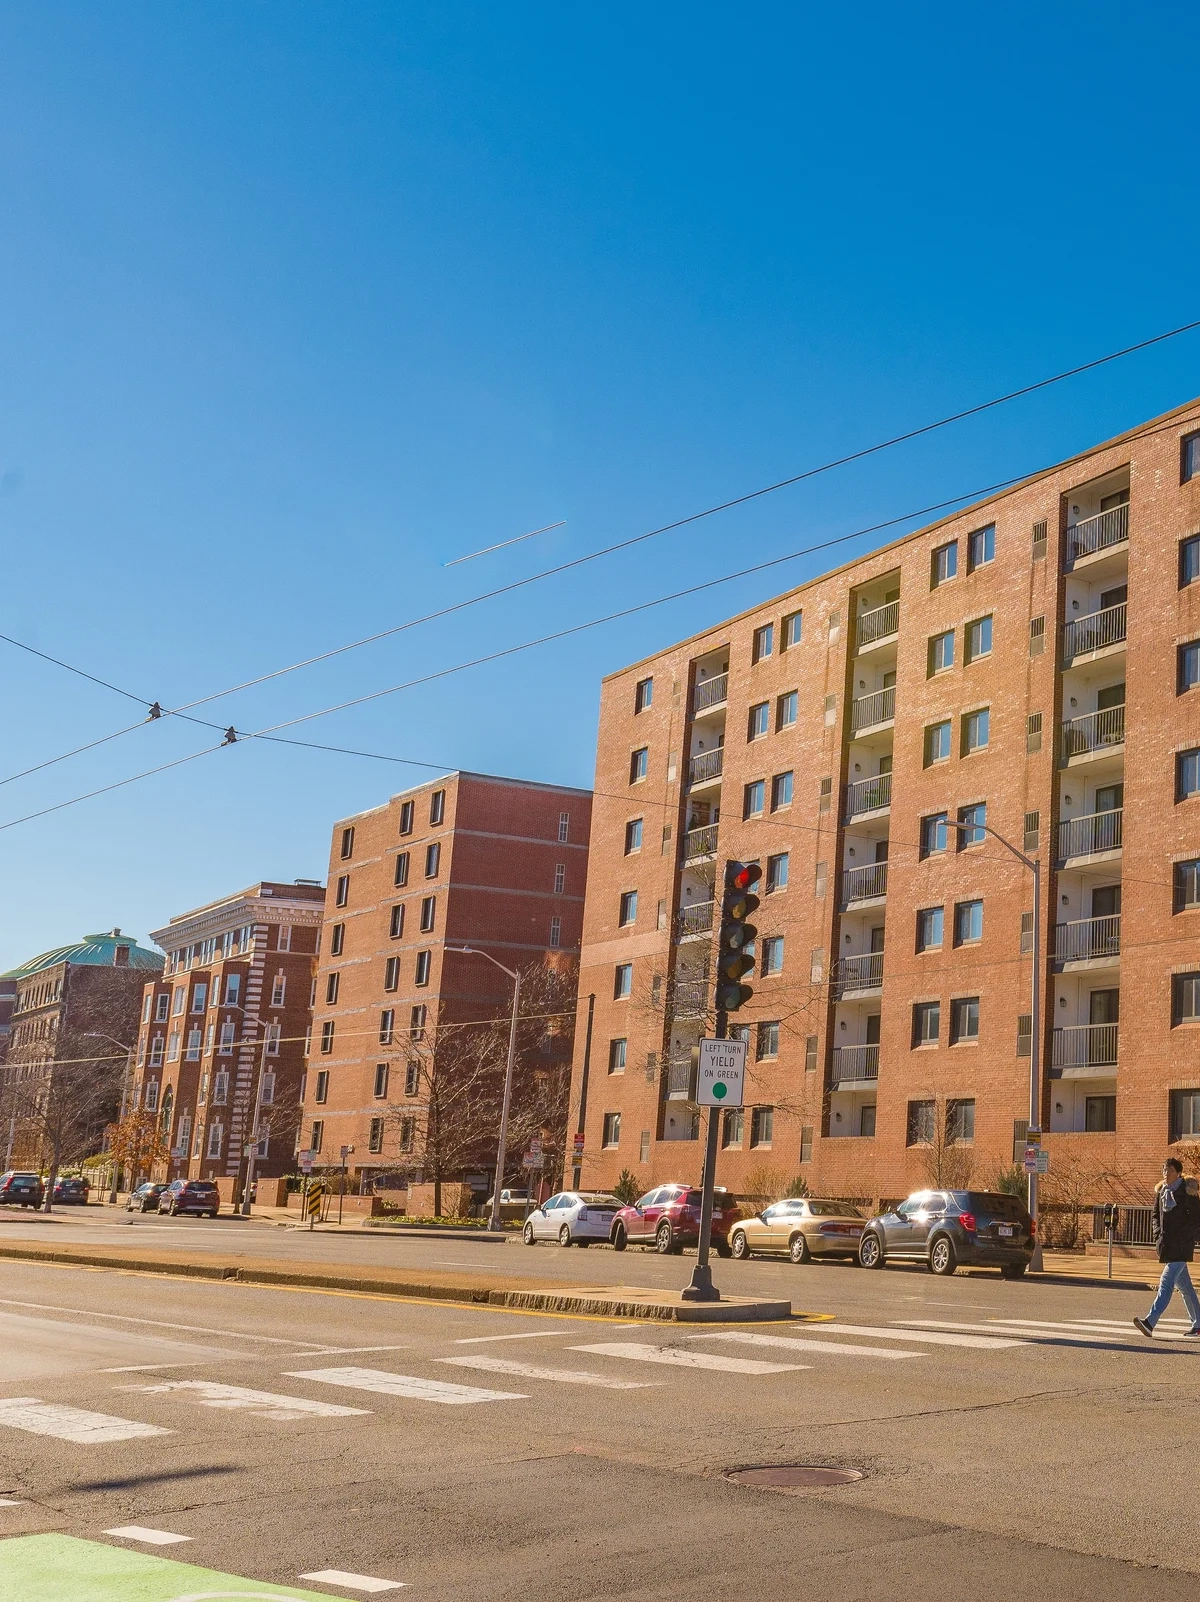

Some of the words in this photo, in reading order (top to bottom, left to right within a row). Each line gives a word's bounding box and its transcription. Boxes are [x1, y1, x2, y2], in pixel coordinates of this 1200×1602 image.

[705, 1044, 721, 1053] LEFT
[723, 1044, 741, 1054] TURN
[710, 1056, 735, 1067] YIELD
[704, 1069, 714, 1078] ON
[717, 1070, 739, 1079] GREEN
